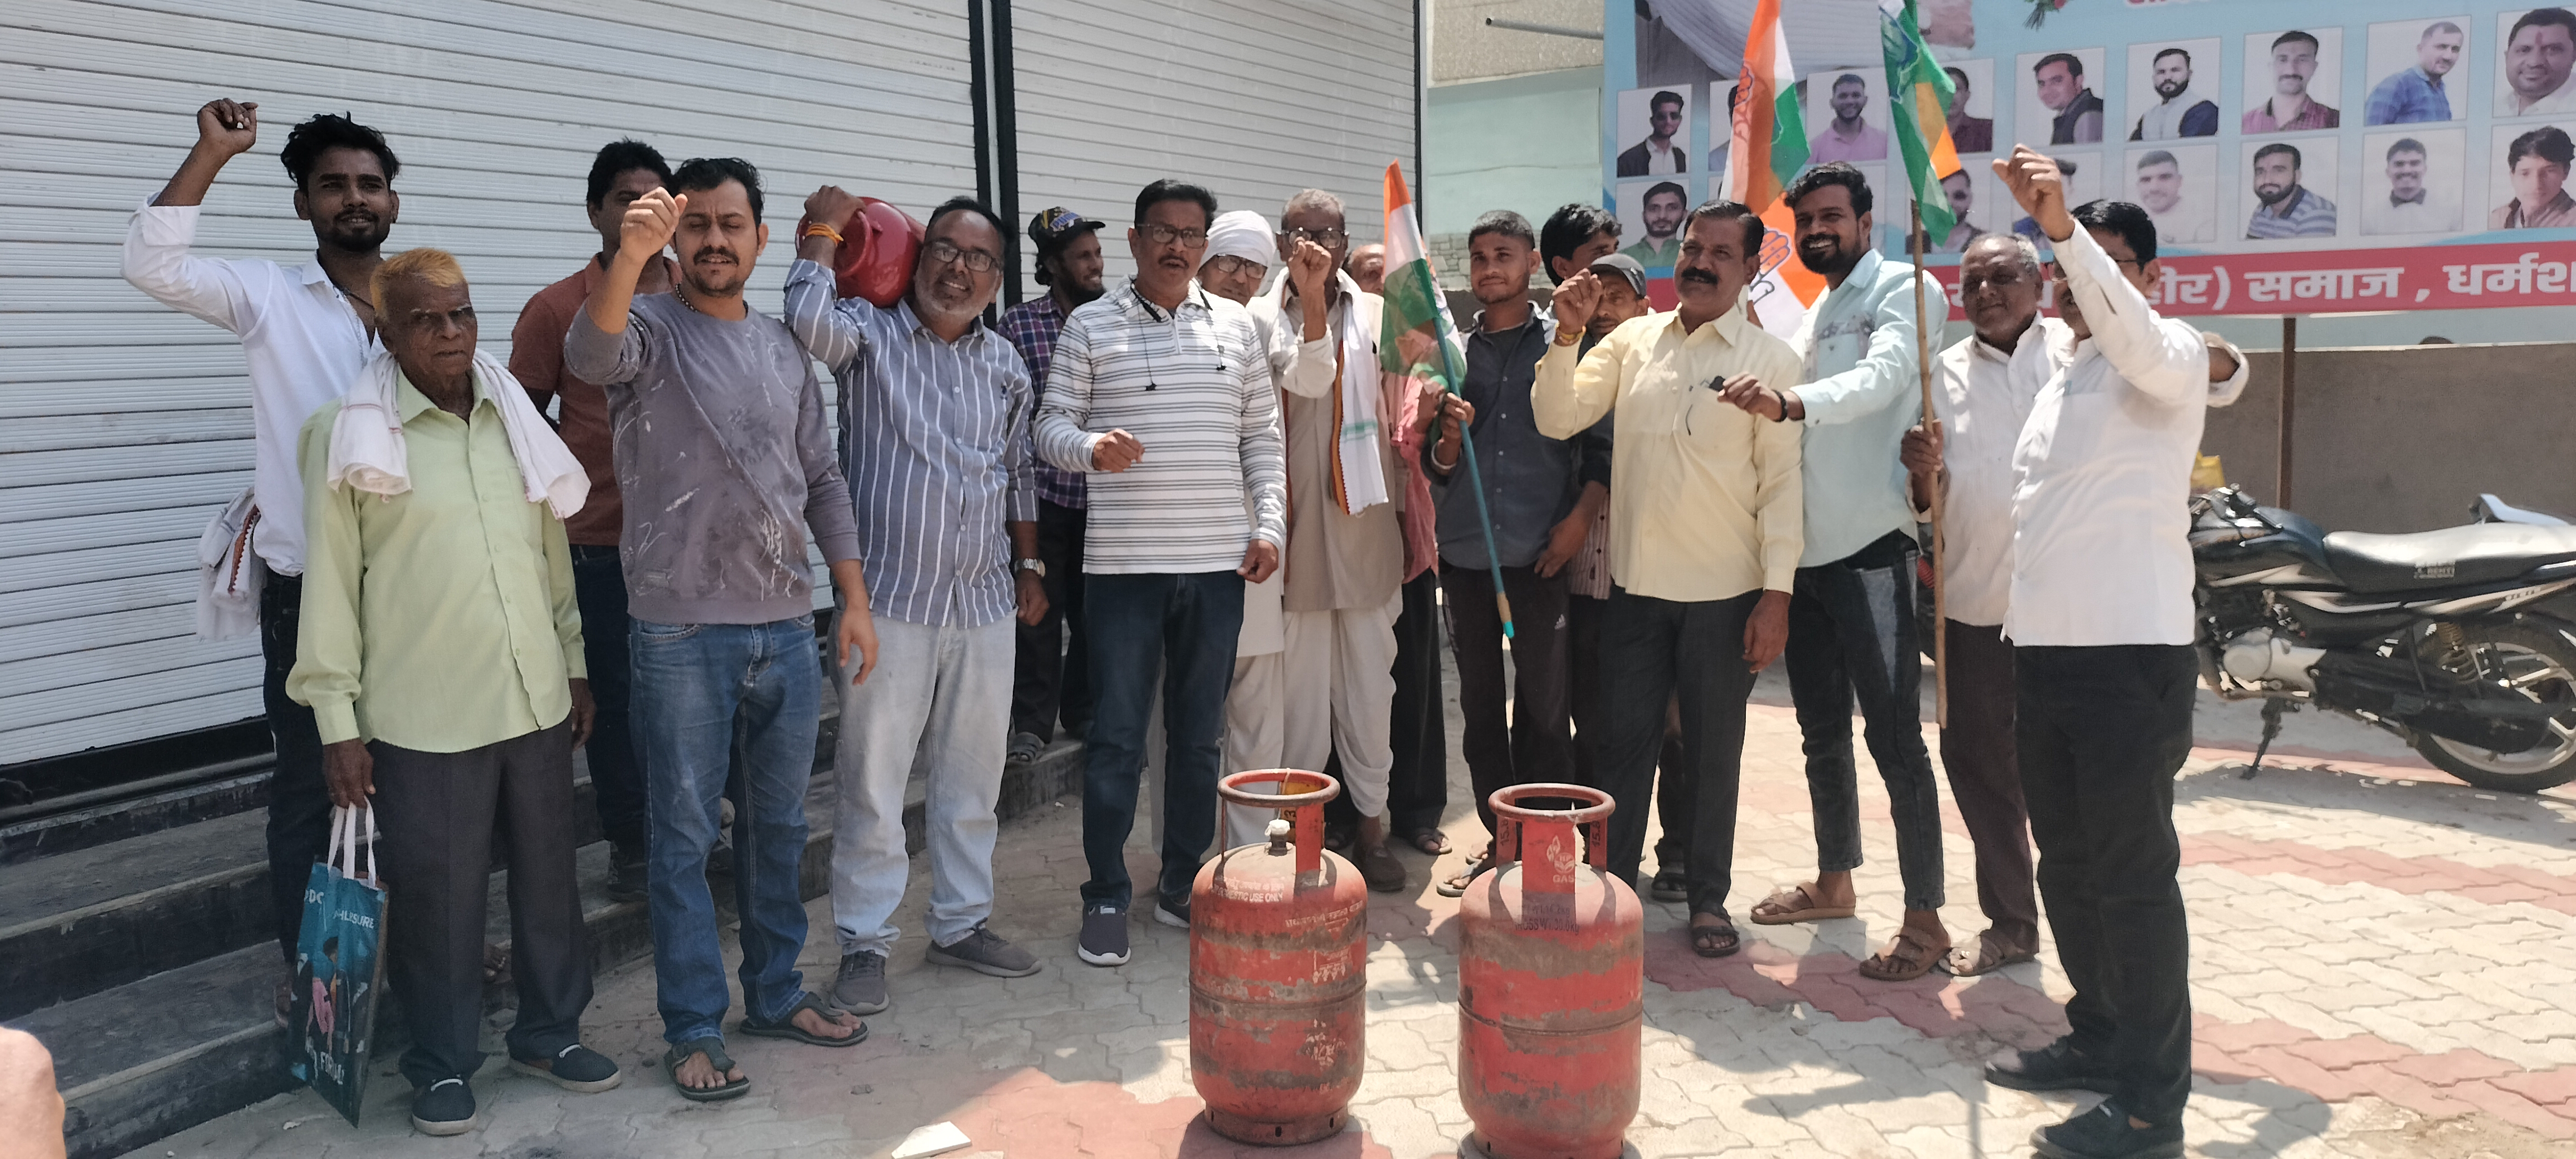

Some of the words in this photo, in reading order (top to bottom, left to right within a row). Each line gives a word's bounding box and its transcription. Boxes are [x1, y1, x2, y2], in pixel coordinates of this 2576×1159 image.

[2243, 267, 2405, 301] समाज
[1553, 874, 1575, 883] GAS
[1250, 893, 1264, 903] USE
[1265, 892, 1283, 903] ONLY
